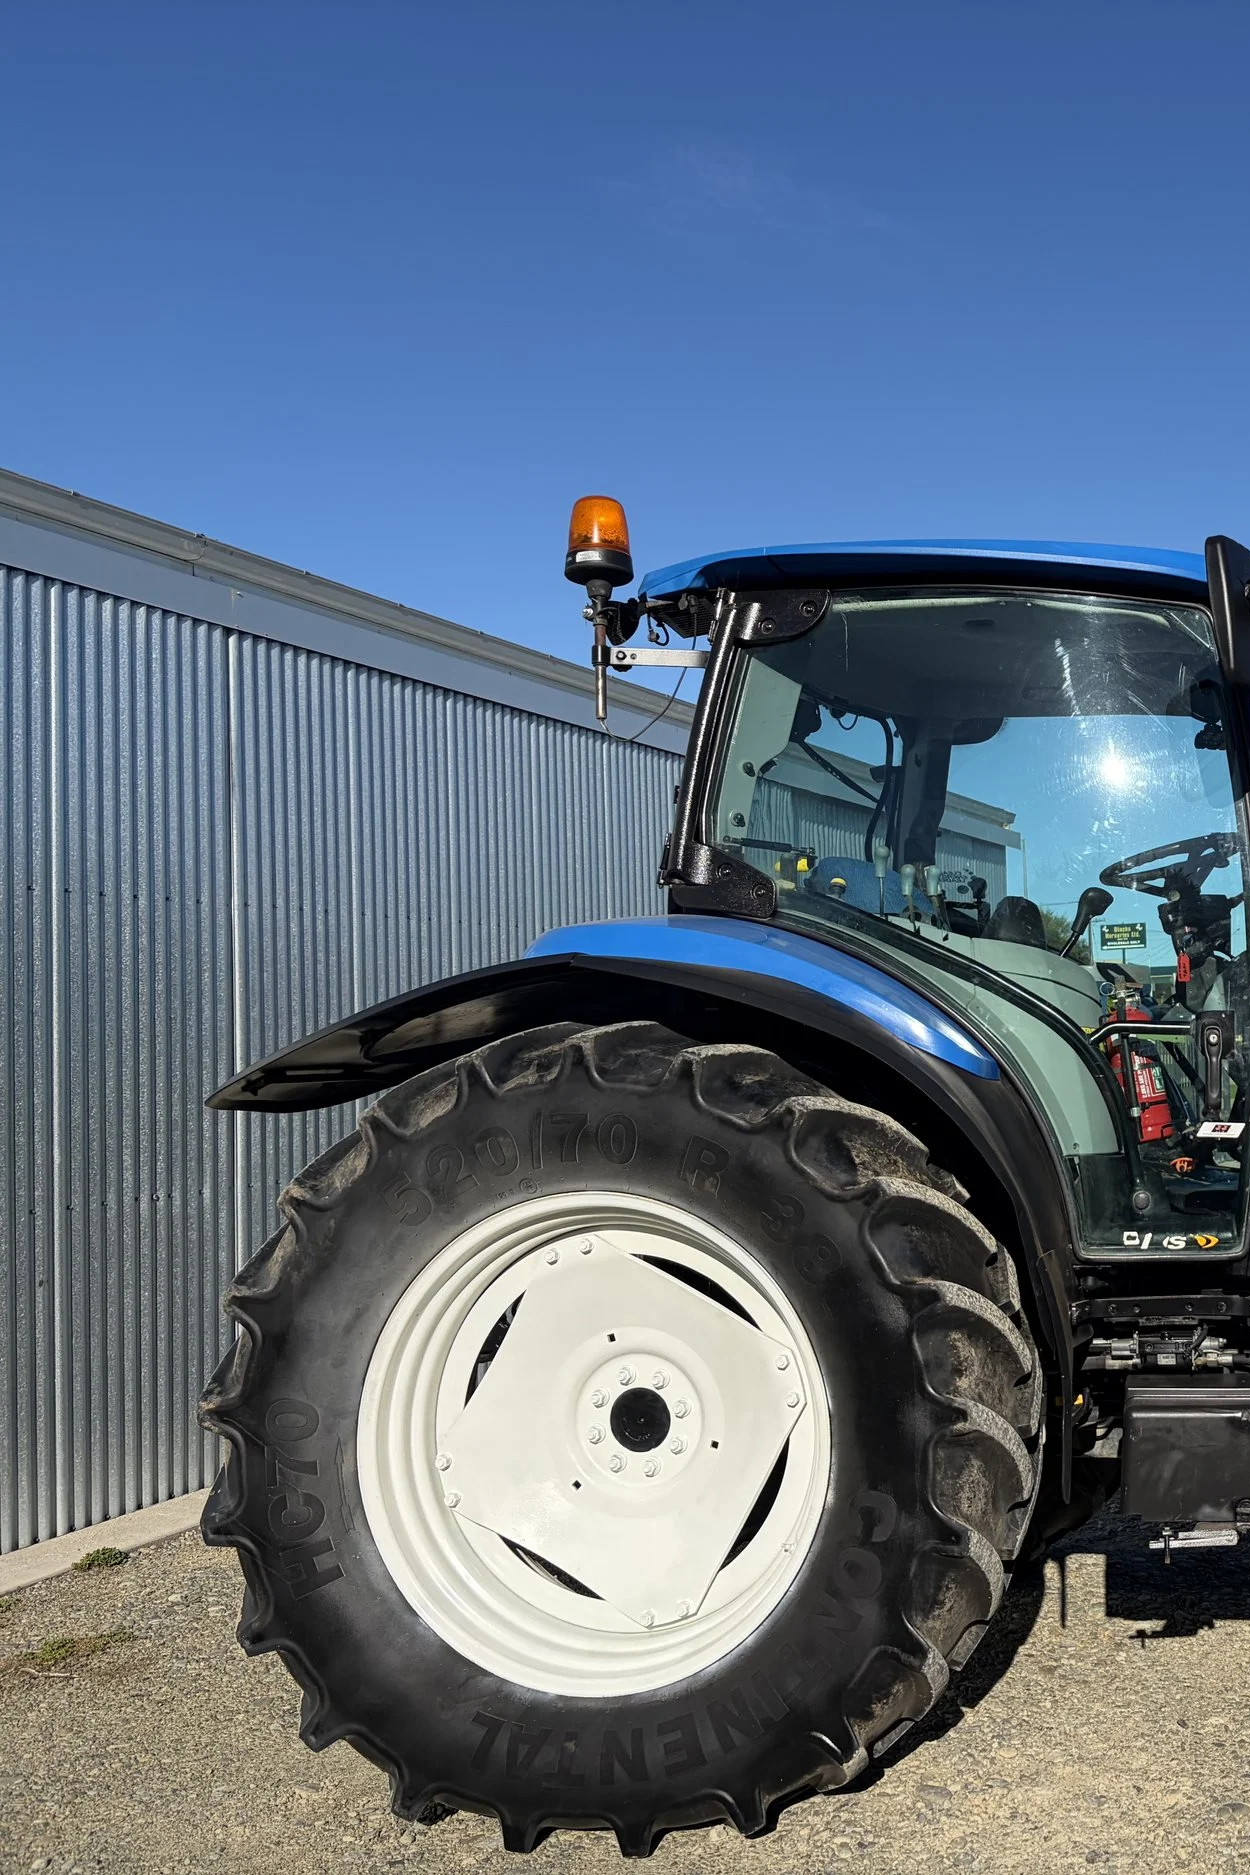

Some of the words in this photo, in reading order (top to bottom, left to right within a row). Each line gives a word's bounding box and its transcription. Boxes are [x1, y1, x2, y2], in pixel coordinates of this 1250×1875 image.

[379, 1111, 638, 1227] 520/70
[680, 1134, 730, 1199] R
[759, 1194, 842, 1286] 38
[264, 1397, 346, 1601] HC70
[469, 1489, 899, 1788] CONTINENTAL
